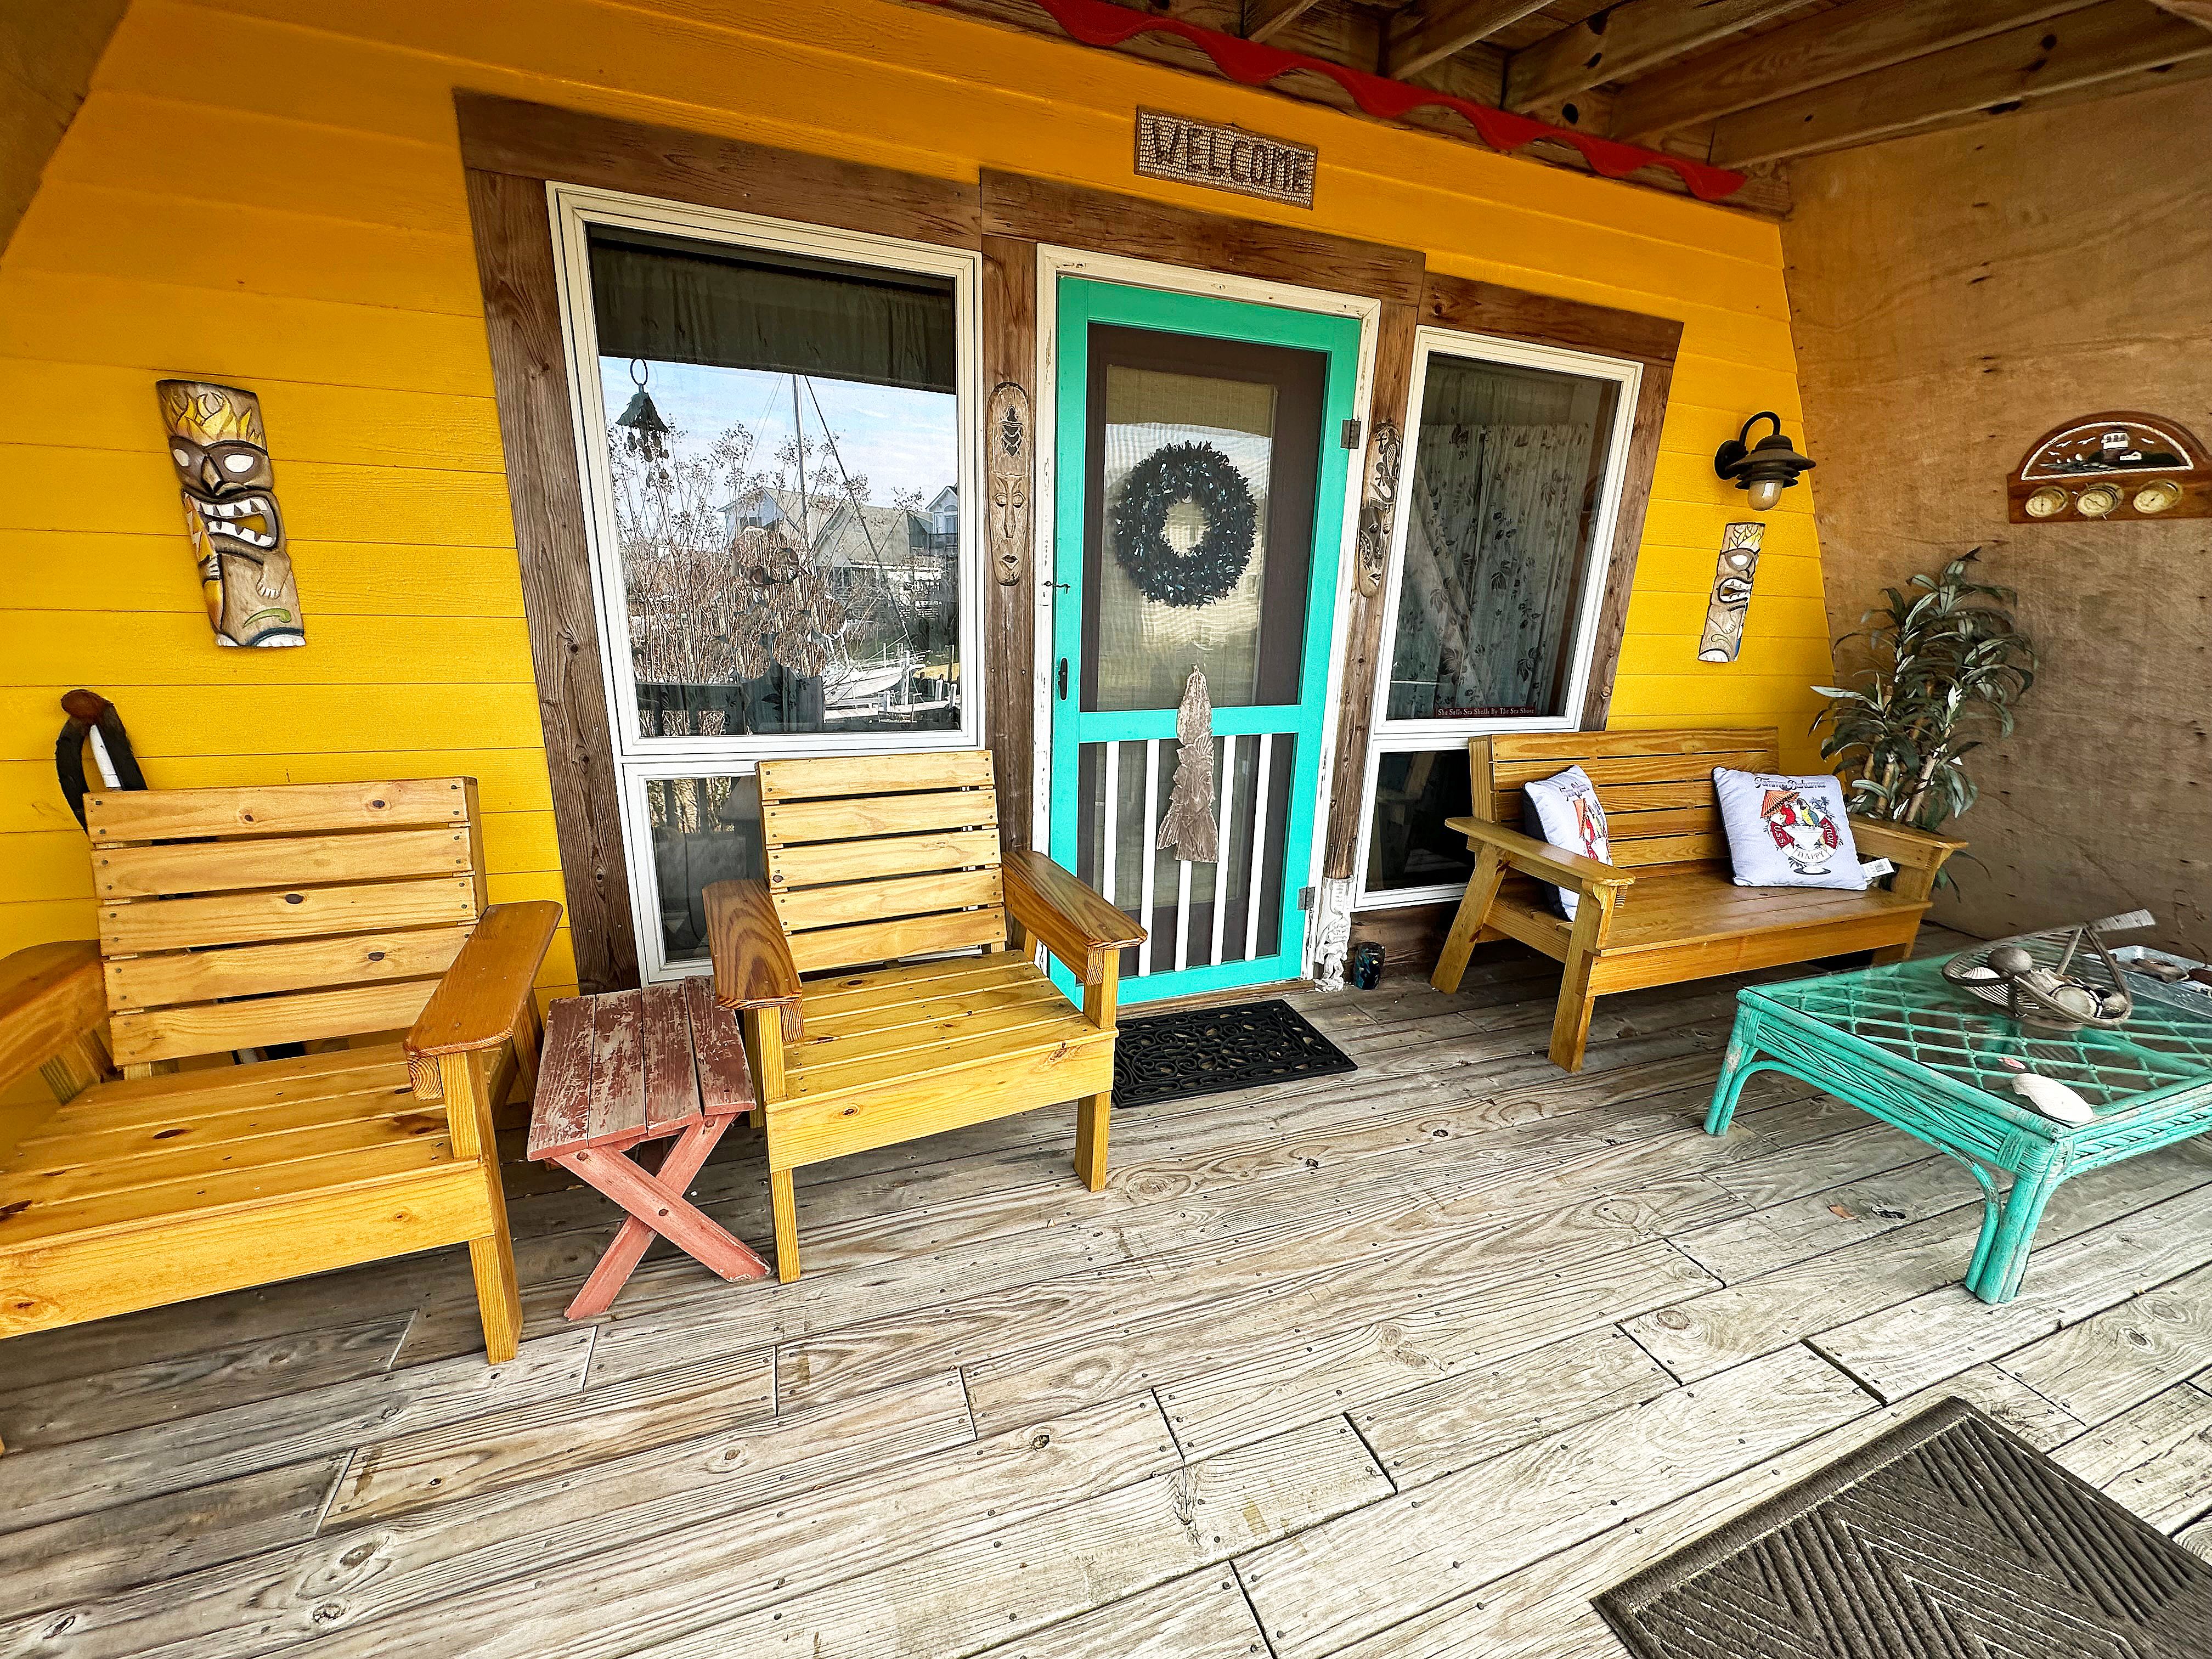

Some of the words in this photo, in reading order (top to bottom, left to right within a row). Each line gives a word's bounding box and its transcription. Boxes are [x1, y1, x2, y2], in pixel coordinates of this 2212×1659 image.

[1153, 121, 1308, 192] WELCOME
[1797, 850, 1824, 860] HAPPY
[1822, 822, 1834, 846] HOUR
